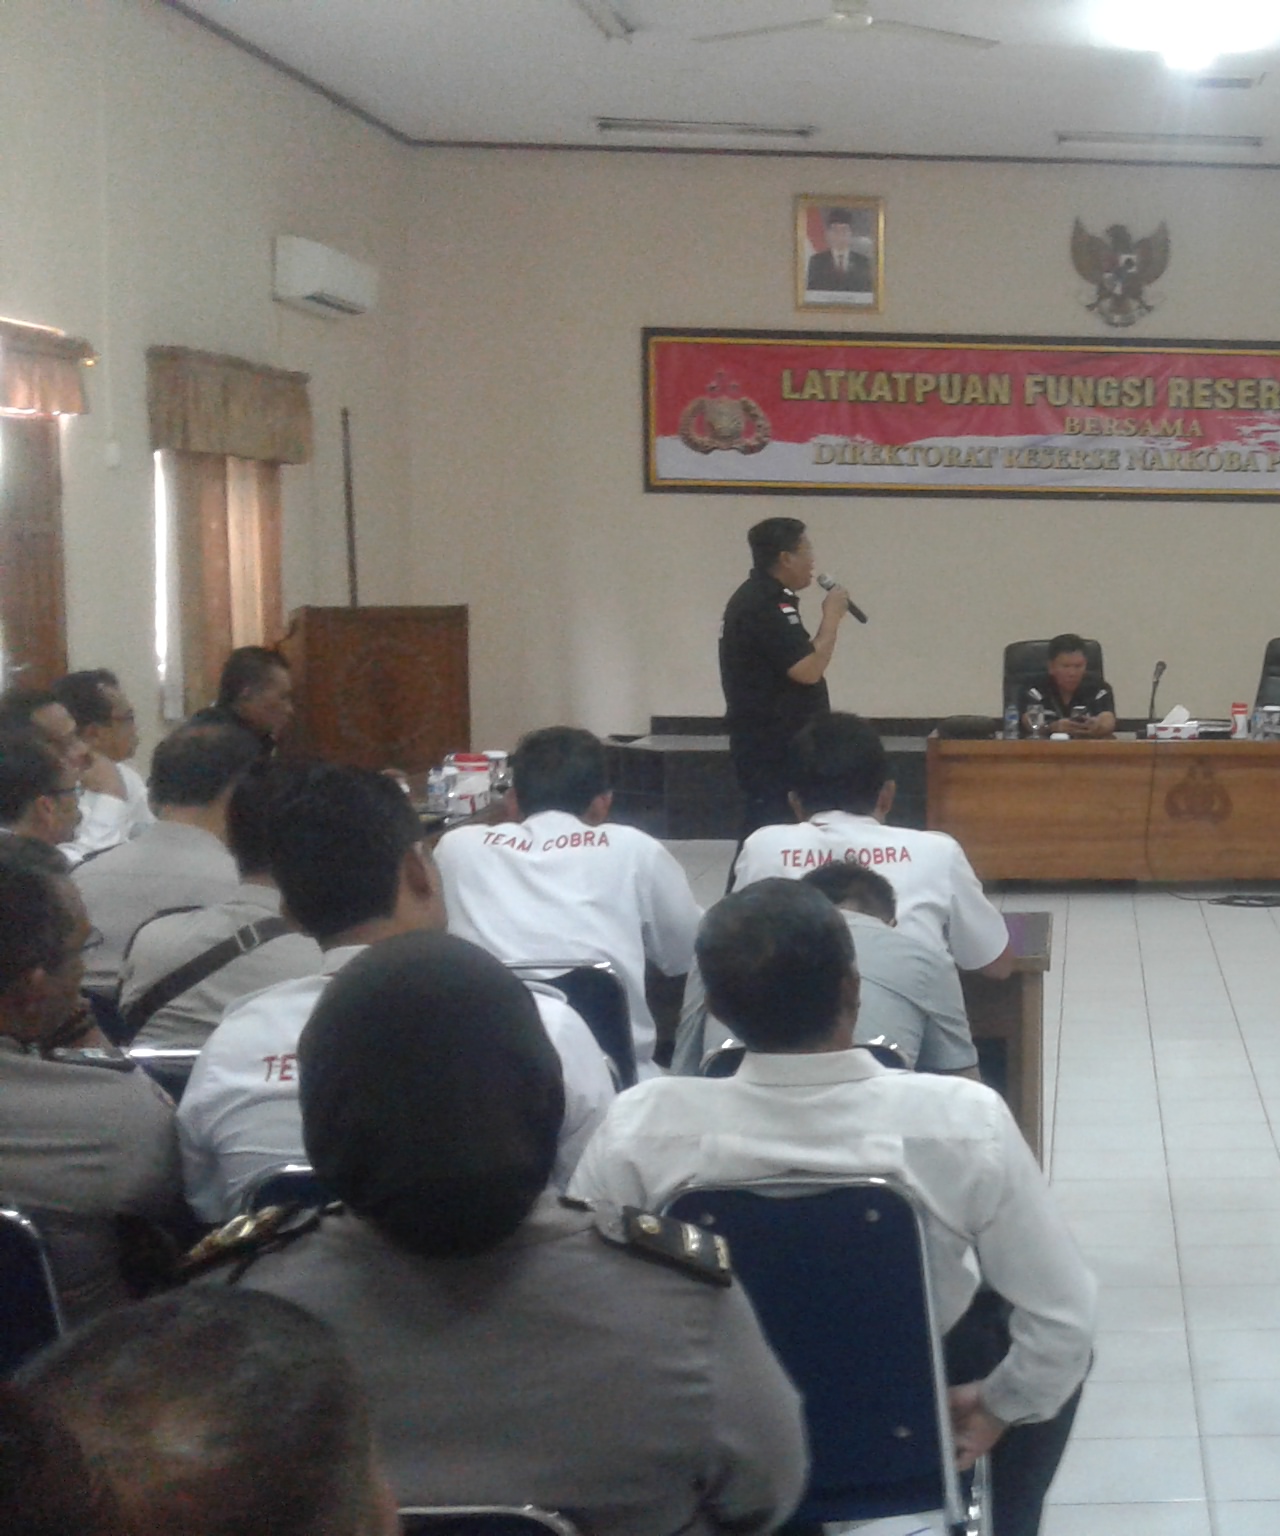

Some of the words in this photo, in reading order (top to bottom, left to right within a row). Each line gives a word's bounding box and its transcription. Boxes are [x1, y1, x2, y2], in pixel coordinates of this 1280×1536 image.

[781, 368, 1012, 406] LATKATPUAN
[1024, 373, 1155, 409] FUNGSI
[1063, 416, 1204, 438] BERSAMA
[813, 443, 998, 468] DIREKTORAT
[1003, 446, 1120, 471] RESERSE
[1126, 448, 1261, 473] NARKOBA
[483, 831, 533, 853] TEAM
[542, 830, 610, 852] COBRA
[781, 848, 833, 868] TEAM
[843, 846, 912, 868] COBRA
